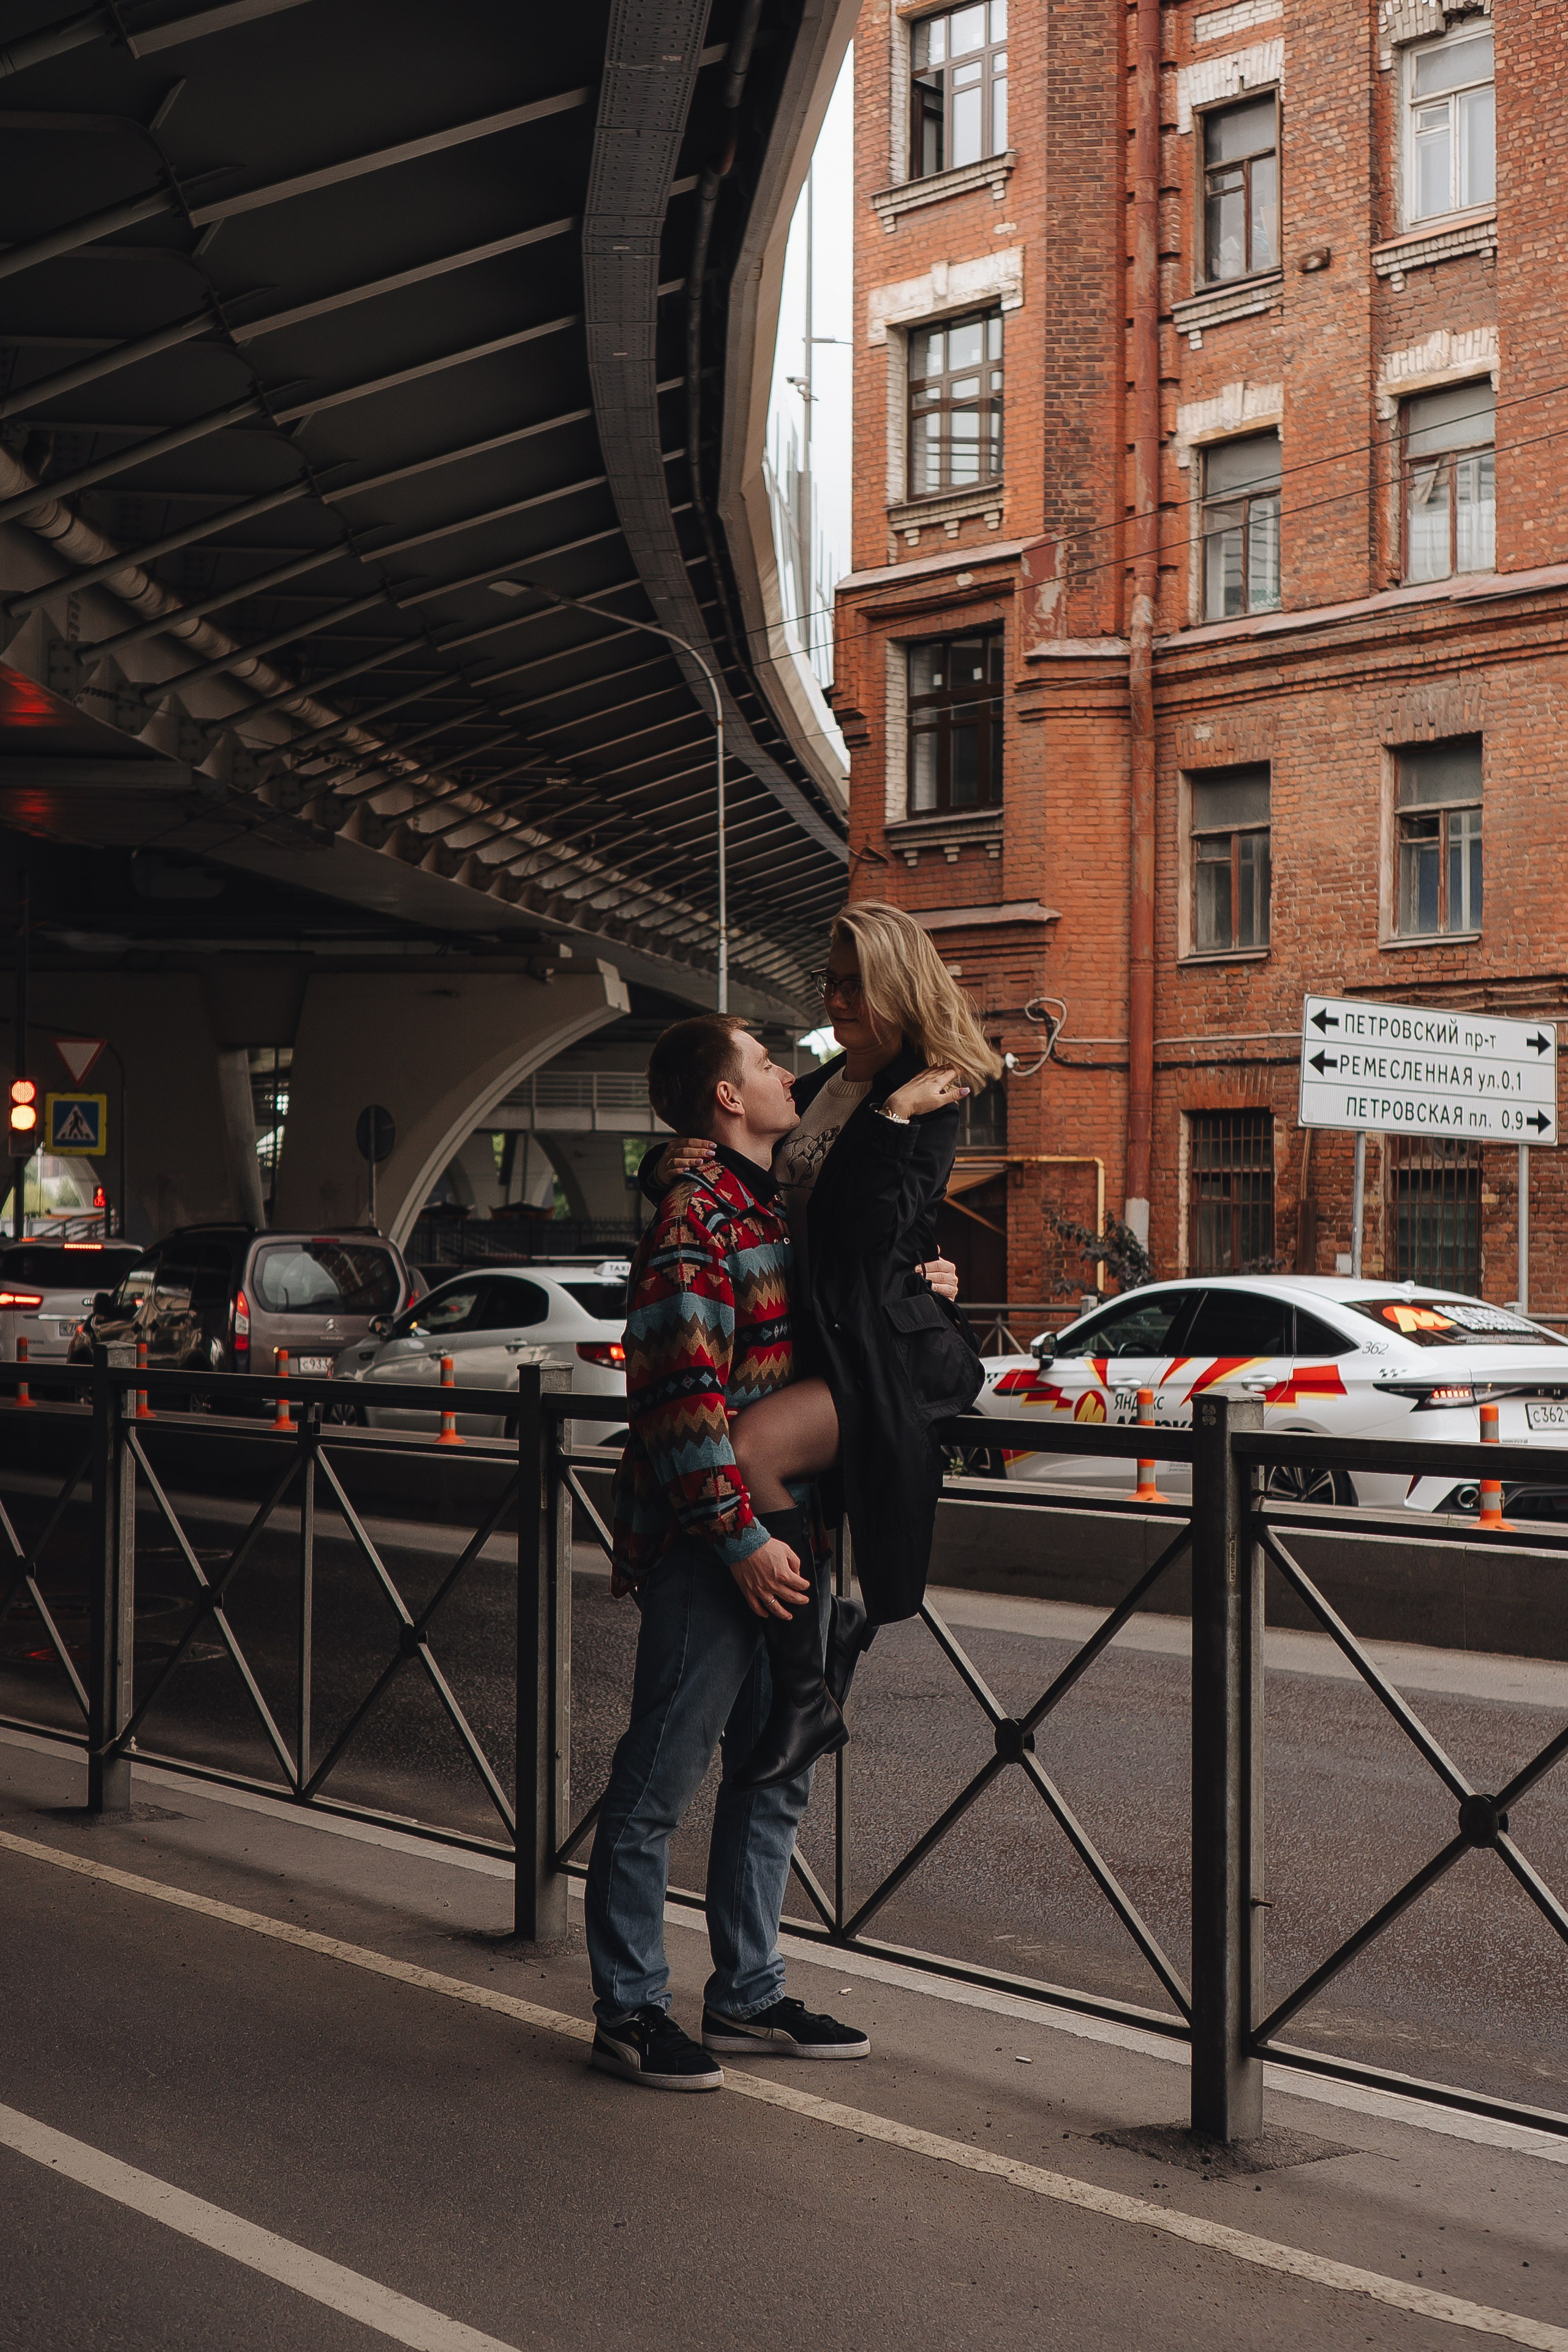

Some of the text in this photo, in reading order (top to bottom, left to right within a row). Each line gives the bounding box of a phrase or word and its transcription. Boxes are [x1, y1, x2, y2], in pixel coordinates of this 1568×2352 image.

[1345, 1013, 1496, 1052] ПЕТРОВСКИЙ пр-т
[1340, 1054, 1472, 1086] РЕМЕСЛЕННАЯ
[1346, 1096, 1523, 1131] ПЕТРОВСКАЯ пл. 0,9
[1362, 1341, 1389, 1355] 362
